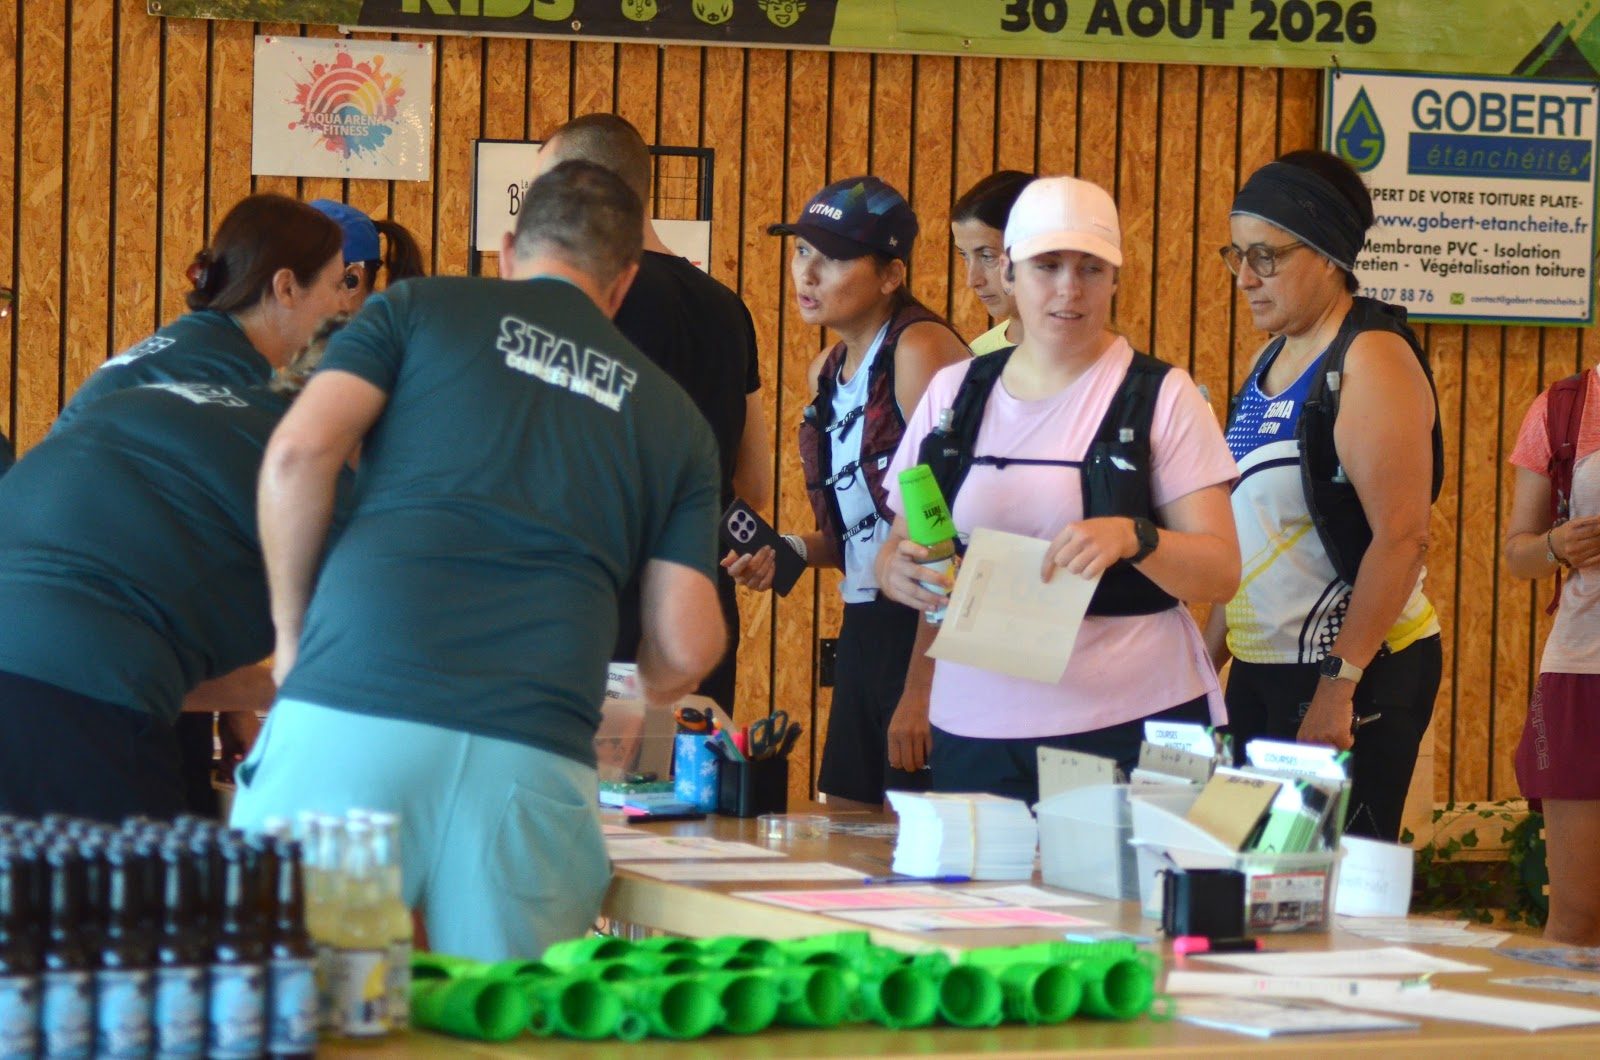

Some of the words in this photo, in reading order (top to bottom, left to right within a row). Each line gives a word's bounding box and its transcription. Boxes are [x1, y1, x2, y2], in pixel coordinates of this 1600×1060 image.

[1000, 0, 1068, 34] 30
[1249, 1, 1377, 45] 2026
[307, 112, 342, 124] AQUA
[344, 114, 385, 126] ARENA
[1411, 88, 1592, 137] GOBERT
[323, 124, 369, 137] FITNESS
[1368, 188, 1404, 202] PERT
[1409, 189, 1425, 202] DE
[1430, 191, 1474, 205] VOTRE
[1479, 192, 1535, 207] TOITURE
[809, 203, 843, 221] UTMB
[1447, 242, 1478, 256] PVC
[1494, 243, 1561, 260] Isolation
[1420, 258, 1530, 277] Végétalisation
[1535, 262, 1586, 278] toiture
[1381, 288, 1397, 301] 07
[1400, 288, 1415, 302] 88
[1419, 289, 1434, 303] 76
[496, 316, 638, 397] STAFF
